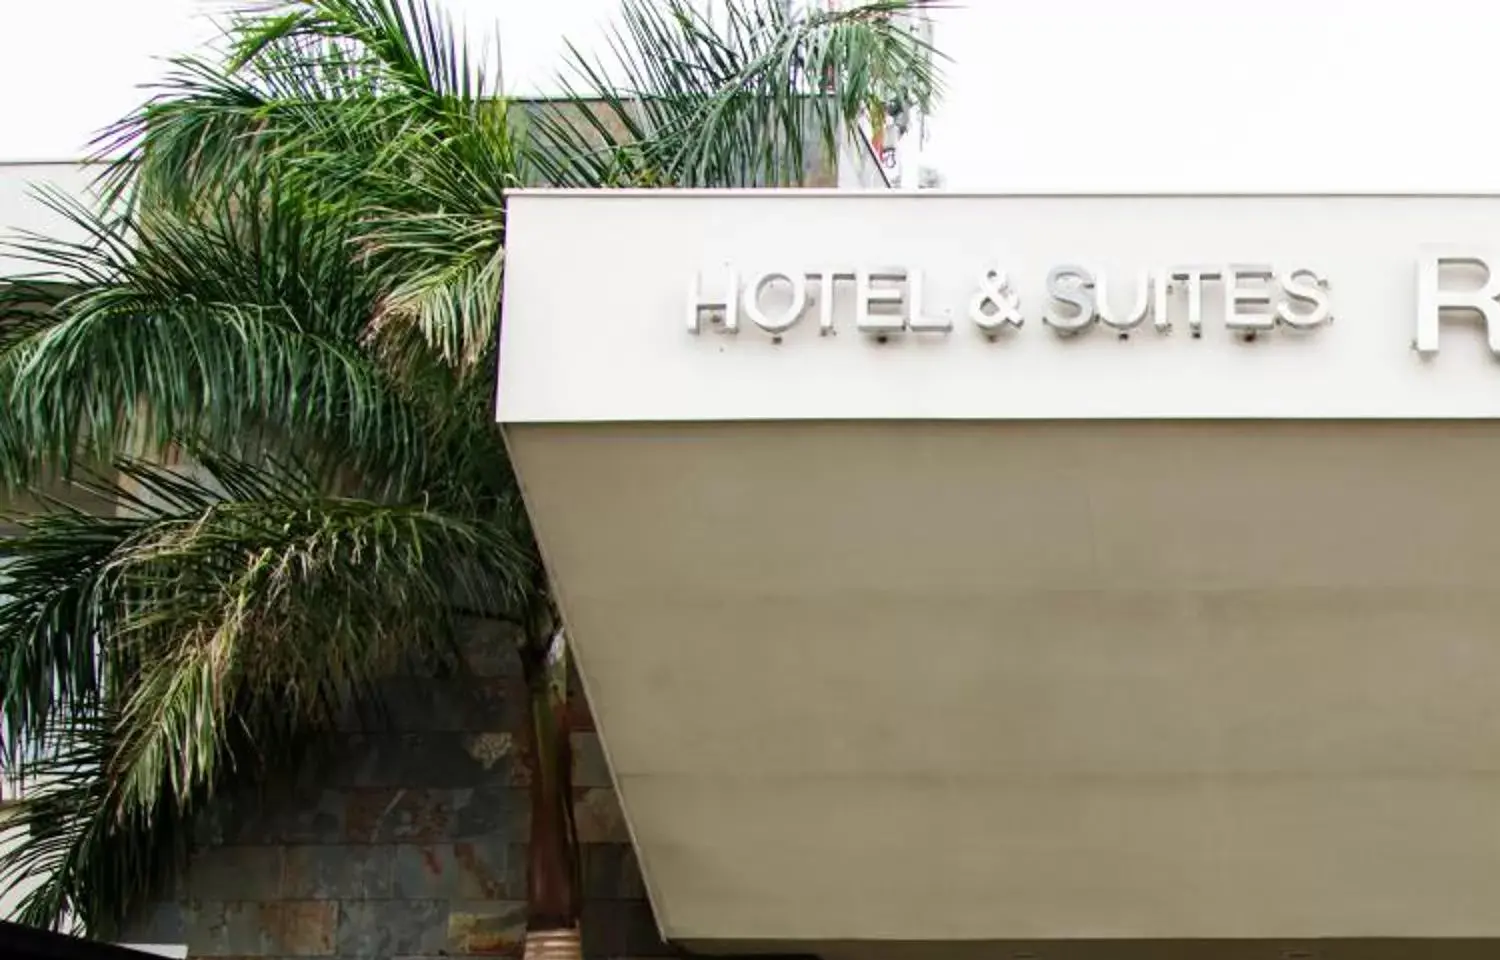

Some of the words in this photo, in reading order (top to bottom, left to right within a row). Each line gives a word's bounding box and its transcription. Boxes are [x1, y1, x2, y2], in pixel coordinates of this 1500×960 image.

[687, 263, 953, 334] HOTEL
[968, 267, 1025, 331] &
[1044, 264, 1332, 334] SUITES
